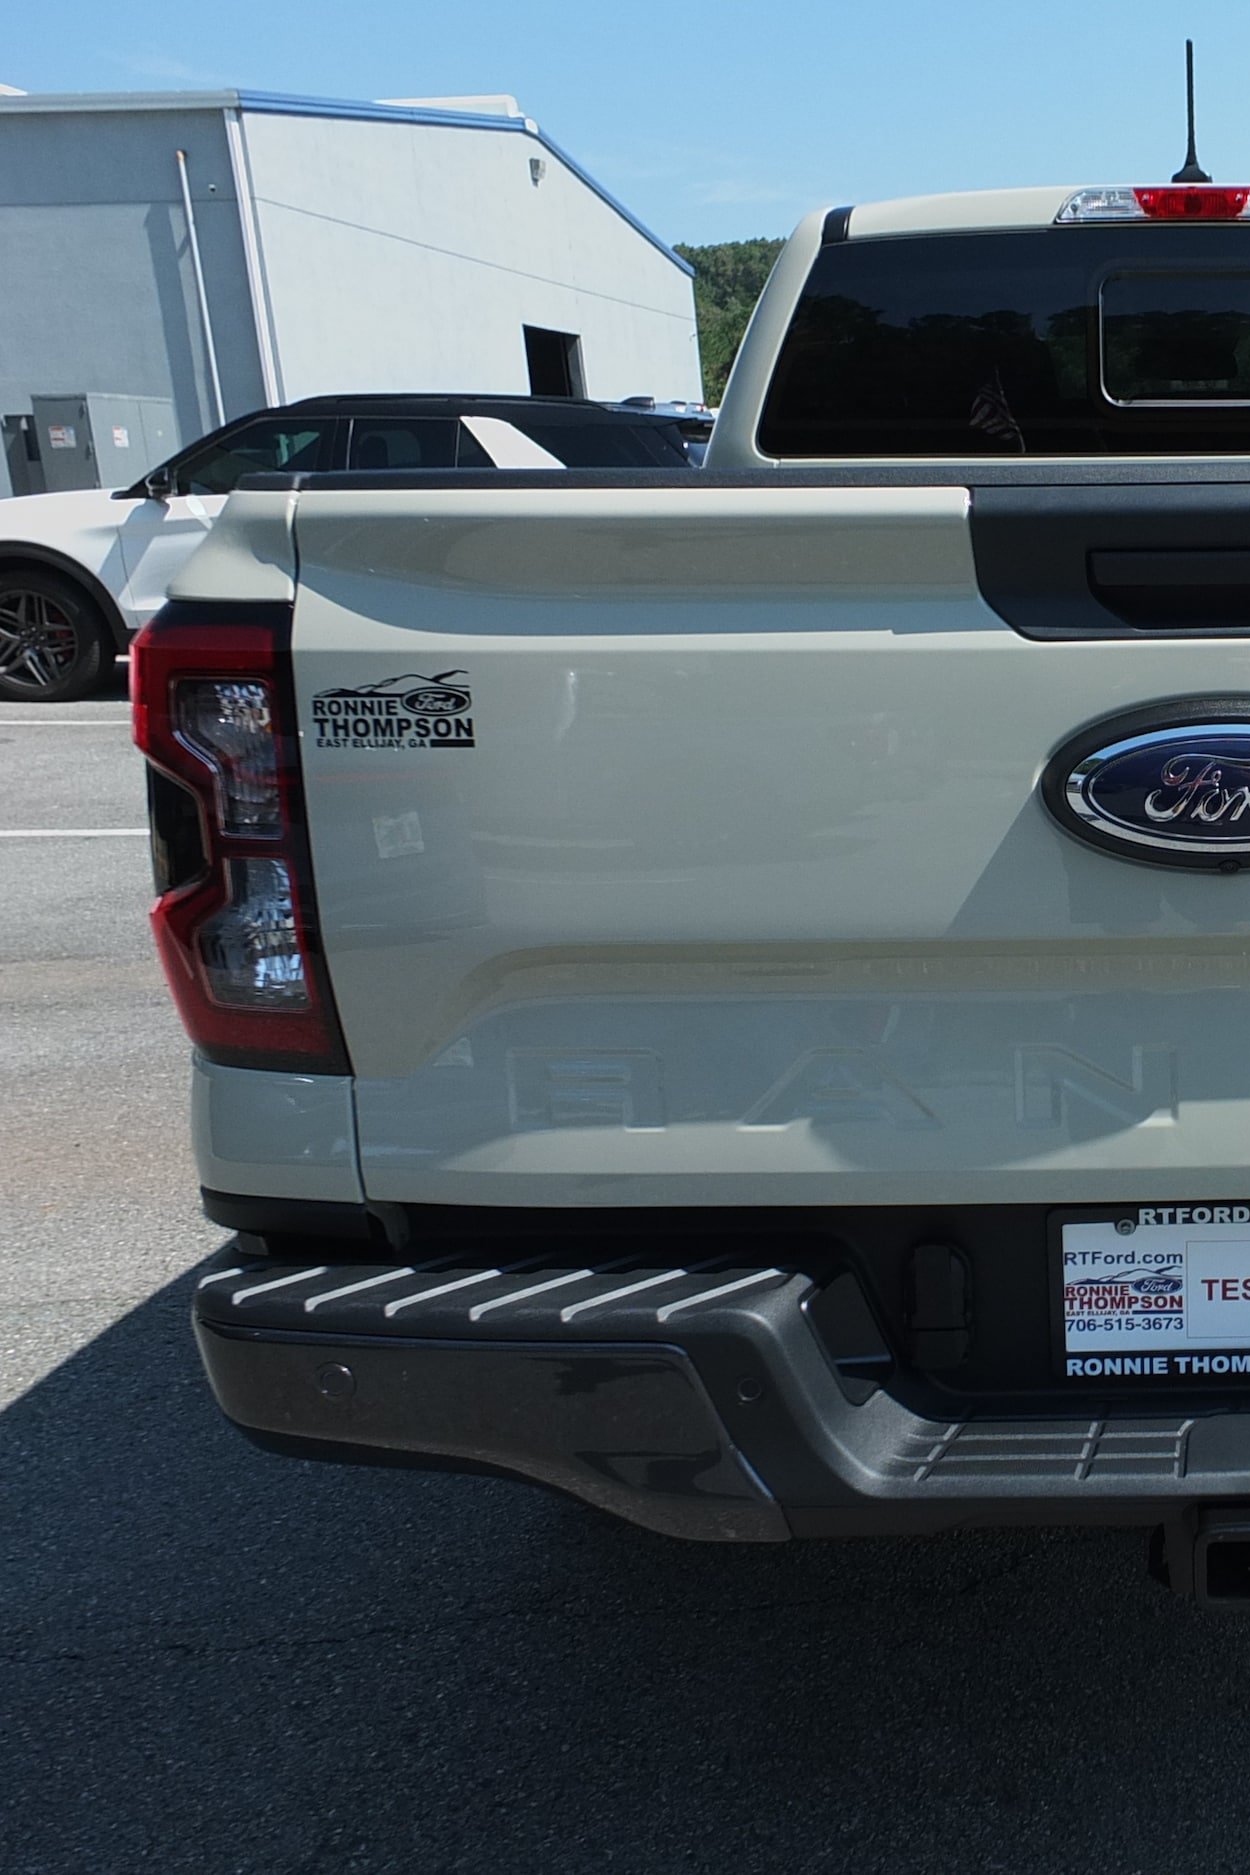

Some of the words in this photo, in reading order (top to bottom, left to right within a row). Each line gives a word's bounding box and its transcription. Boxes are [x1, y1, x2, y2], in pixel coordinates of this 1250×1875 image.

[313, 700, 398, 716] RONNIE
[414, 692, 457, 711] Ford
[313, 718, 474, 738] THOMPSON
[316, 738, 349, 748] EAST
[408, 738, 427, 748] GA
[1064, 1251, 1184, 1266] RTFord.com
[1065, 1285, 1130, 1297] RONNIE
[1140, 1279, 1174, 1292] Ford
[1064, 1296, 1183, 1310] THOMPSON
[1066, 1317, 1184, 1332] 706-515-3673
[1066, 1356, 1169, 1377] RONNIE
